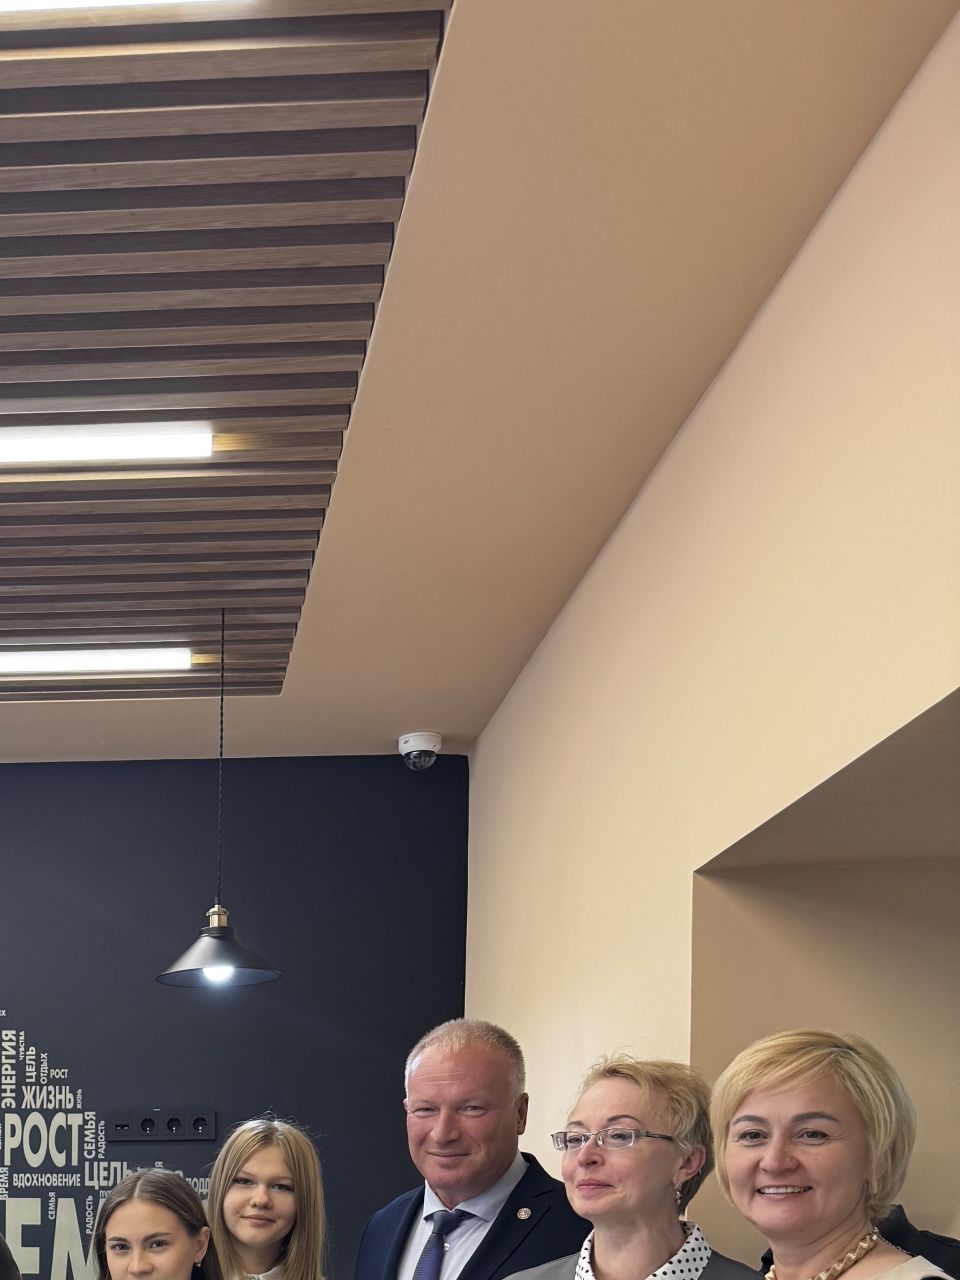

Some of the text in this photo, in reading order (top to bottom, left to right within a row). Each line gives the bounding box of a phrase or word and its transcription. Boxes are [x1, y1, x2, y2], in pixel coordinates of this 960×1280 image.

[0, 1029, 17, 1109] ЭНЕРГИЯ
[25, 1045, 36, 1083] ЦЕЛЬ
[40, 1052, 48, 1084] ОТДЫХ
[50, 1068, 69, 1079] РОСТ
[21, 1085, 74, 1110] ЖИЗНЬ
[4, 1111, 83, 1168] РОСТ
[84, 1111, 96, 1159] СЕМЬЯ
[97, 1120, 106, 1159] РАДОСТЬ
[0, 1166, 9, 1200] ВРЕМЯ
[12, 1173, 81, 1189] ВДОХНОВЕНИЕ
[48, 1192, 56, 1220] СЕМЬЯ
